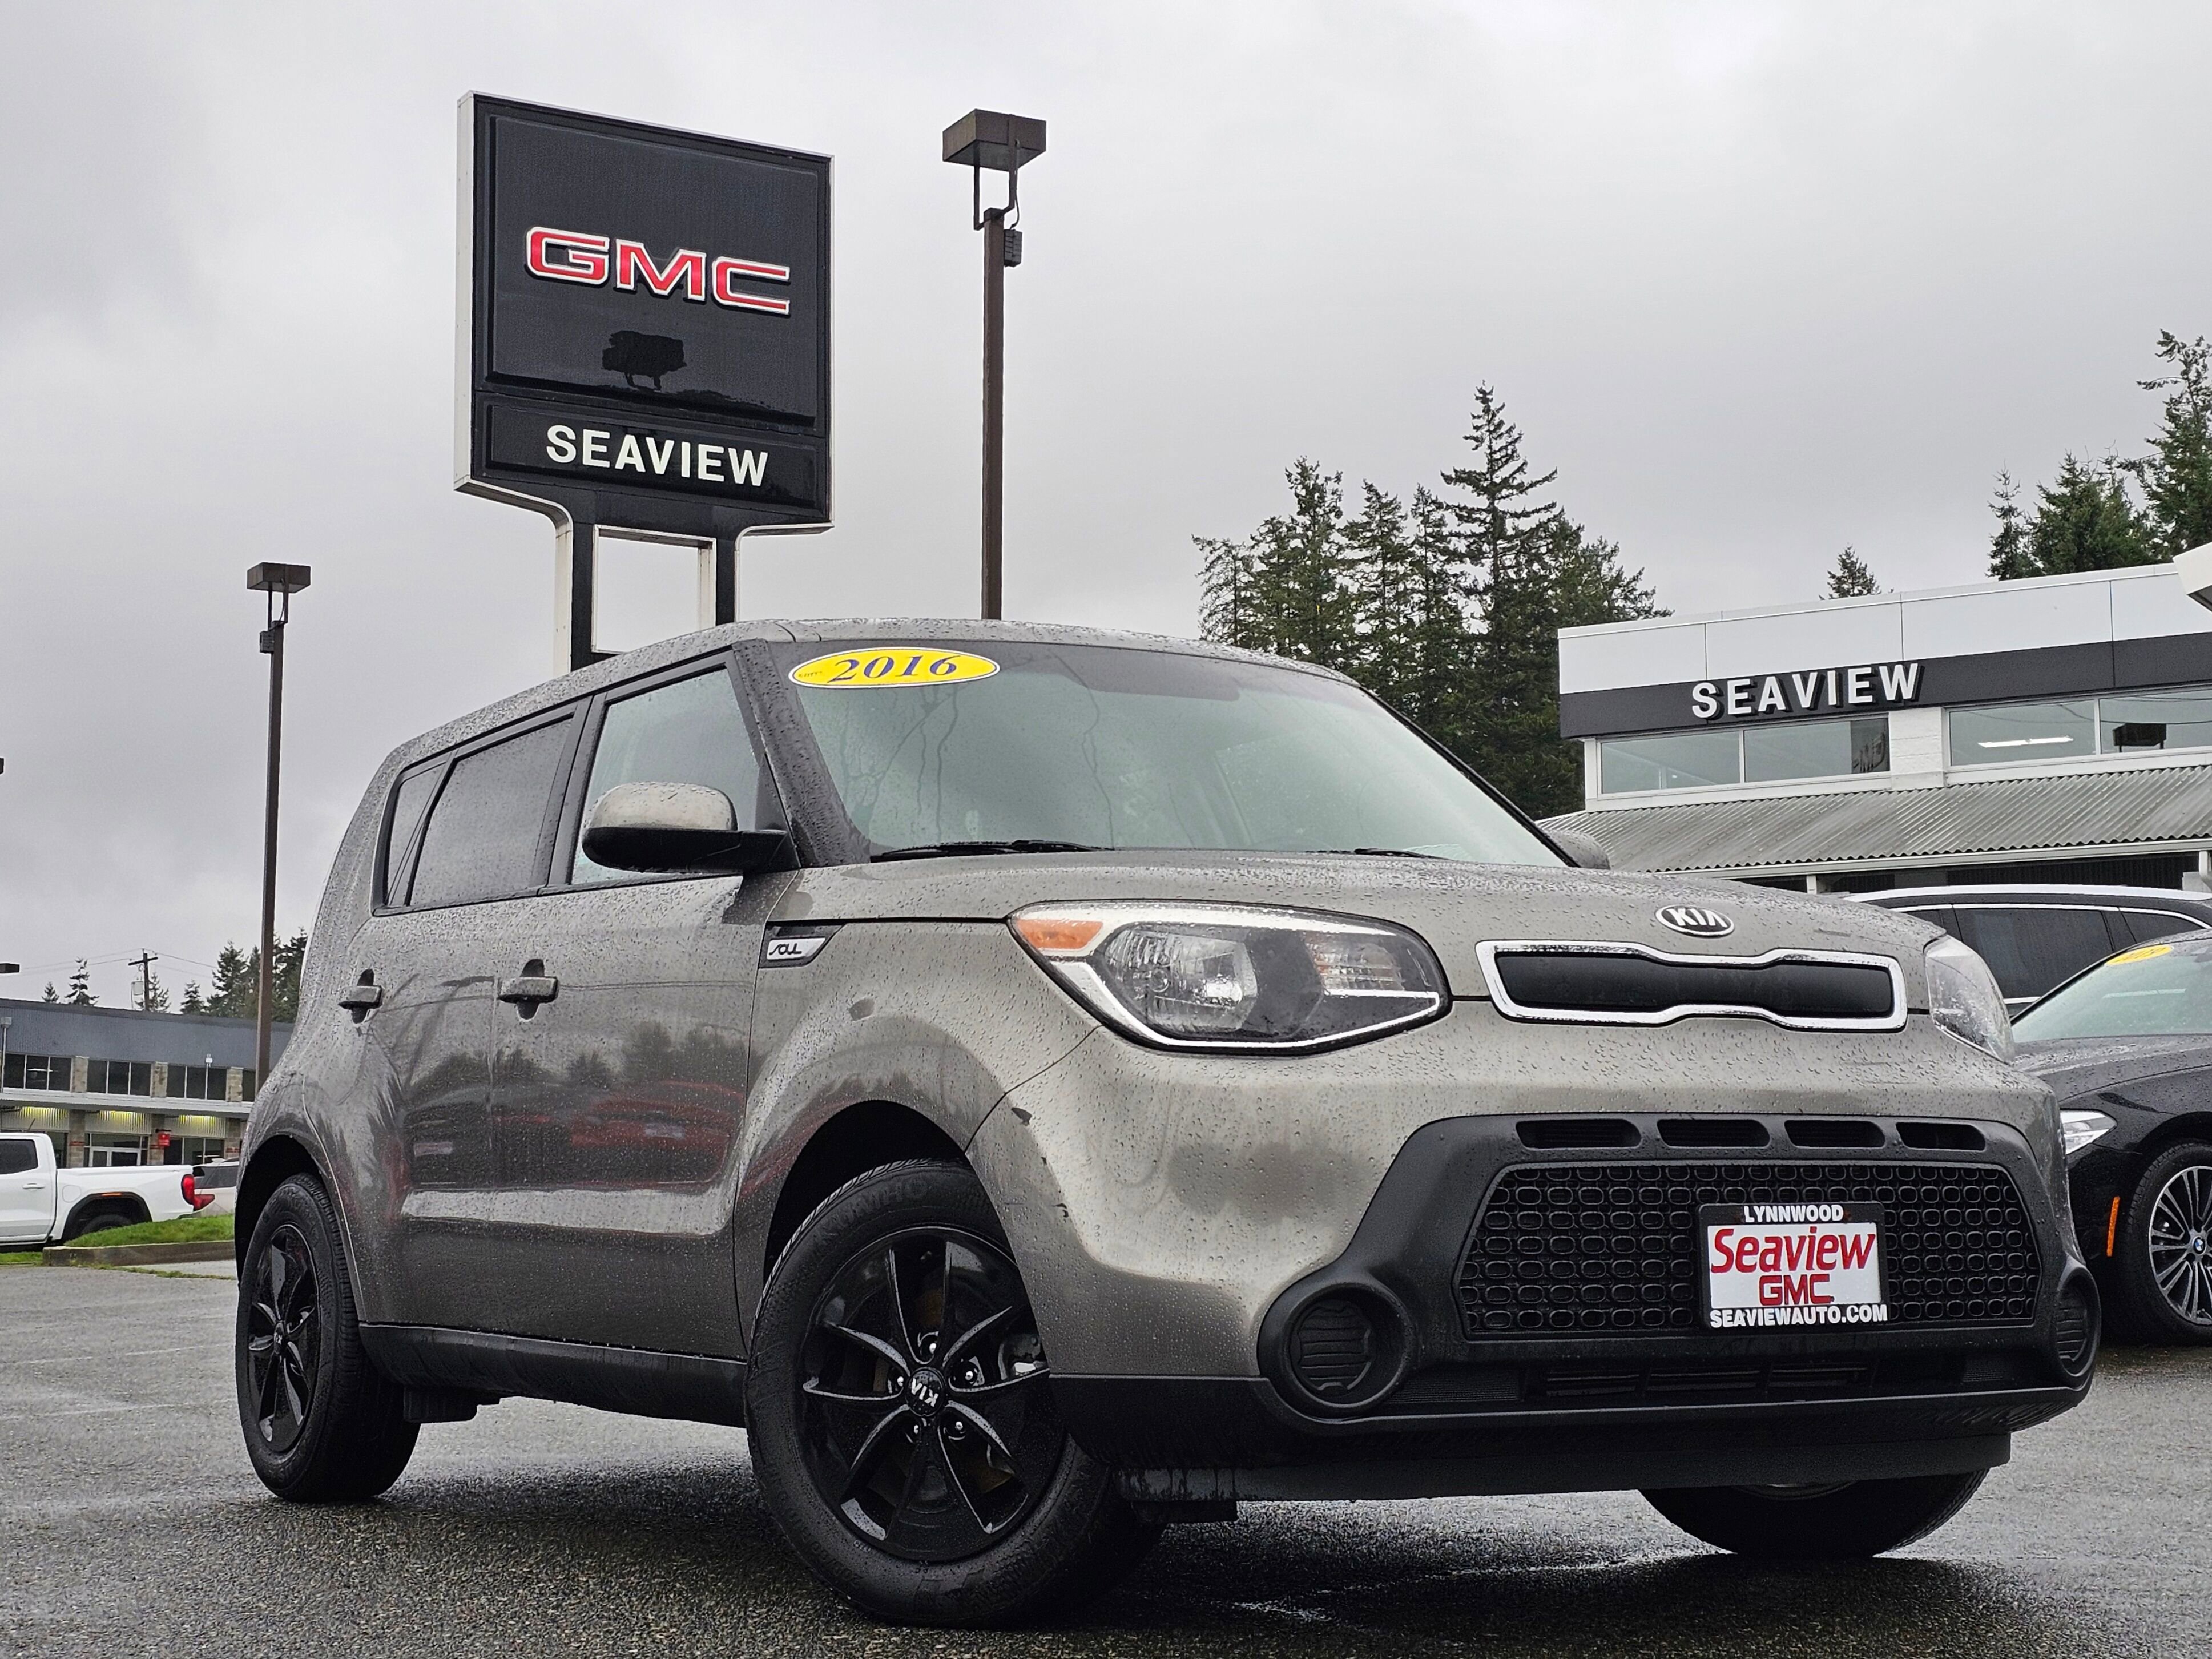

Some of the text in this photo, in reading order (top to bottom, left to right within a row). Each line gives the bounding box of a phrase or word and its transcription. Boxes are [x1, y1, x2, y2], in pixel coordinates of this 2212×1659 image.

[526, 226, 791, 315] GMC
[546, 425, 768, 486] SEAVIEW
[827, 655, 961, 683] 2016
[1691, 663, 1920, 718] SEAVIEW
[1666, 908, 1728, 928] KIA
[1744, 1205, 1843, 1223] LYNNWOOD
[1710, 1226, 1876, 1273] Seaview
[1759, 1274, 1831, 1306] GMC
[1710, 1304, 1888, 1328] SEAVIEWAUTO.COM
